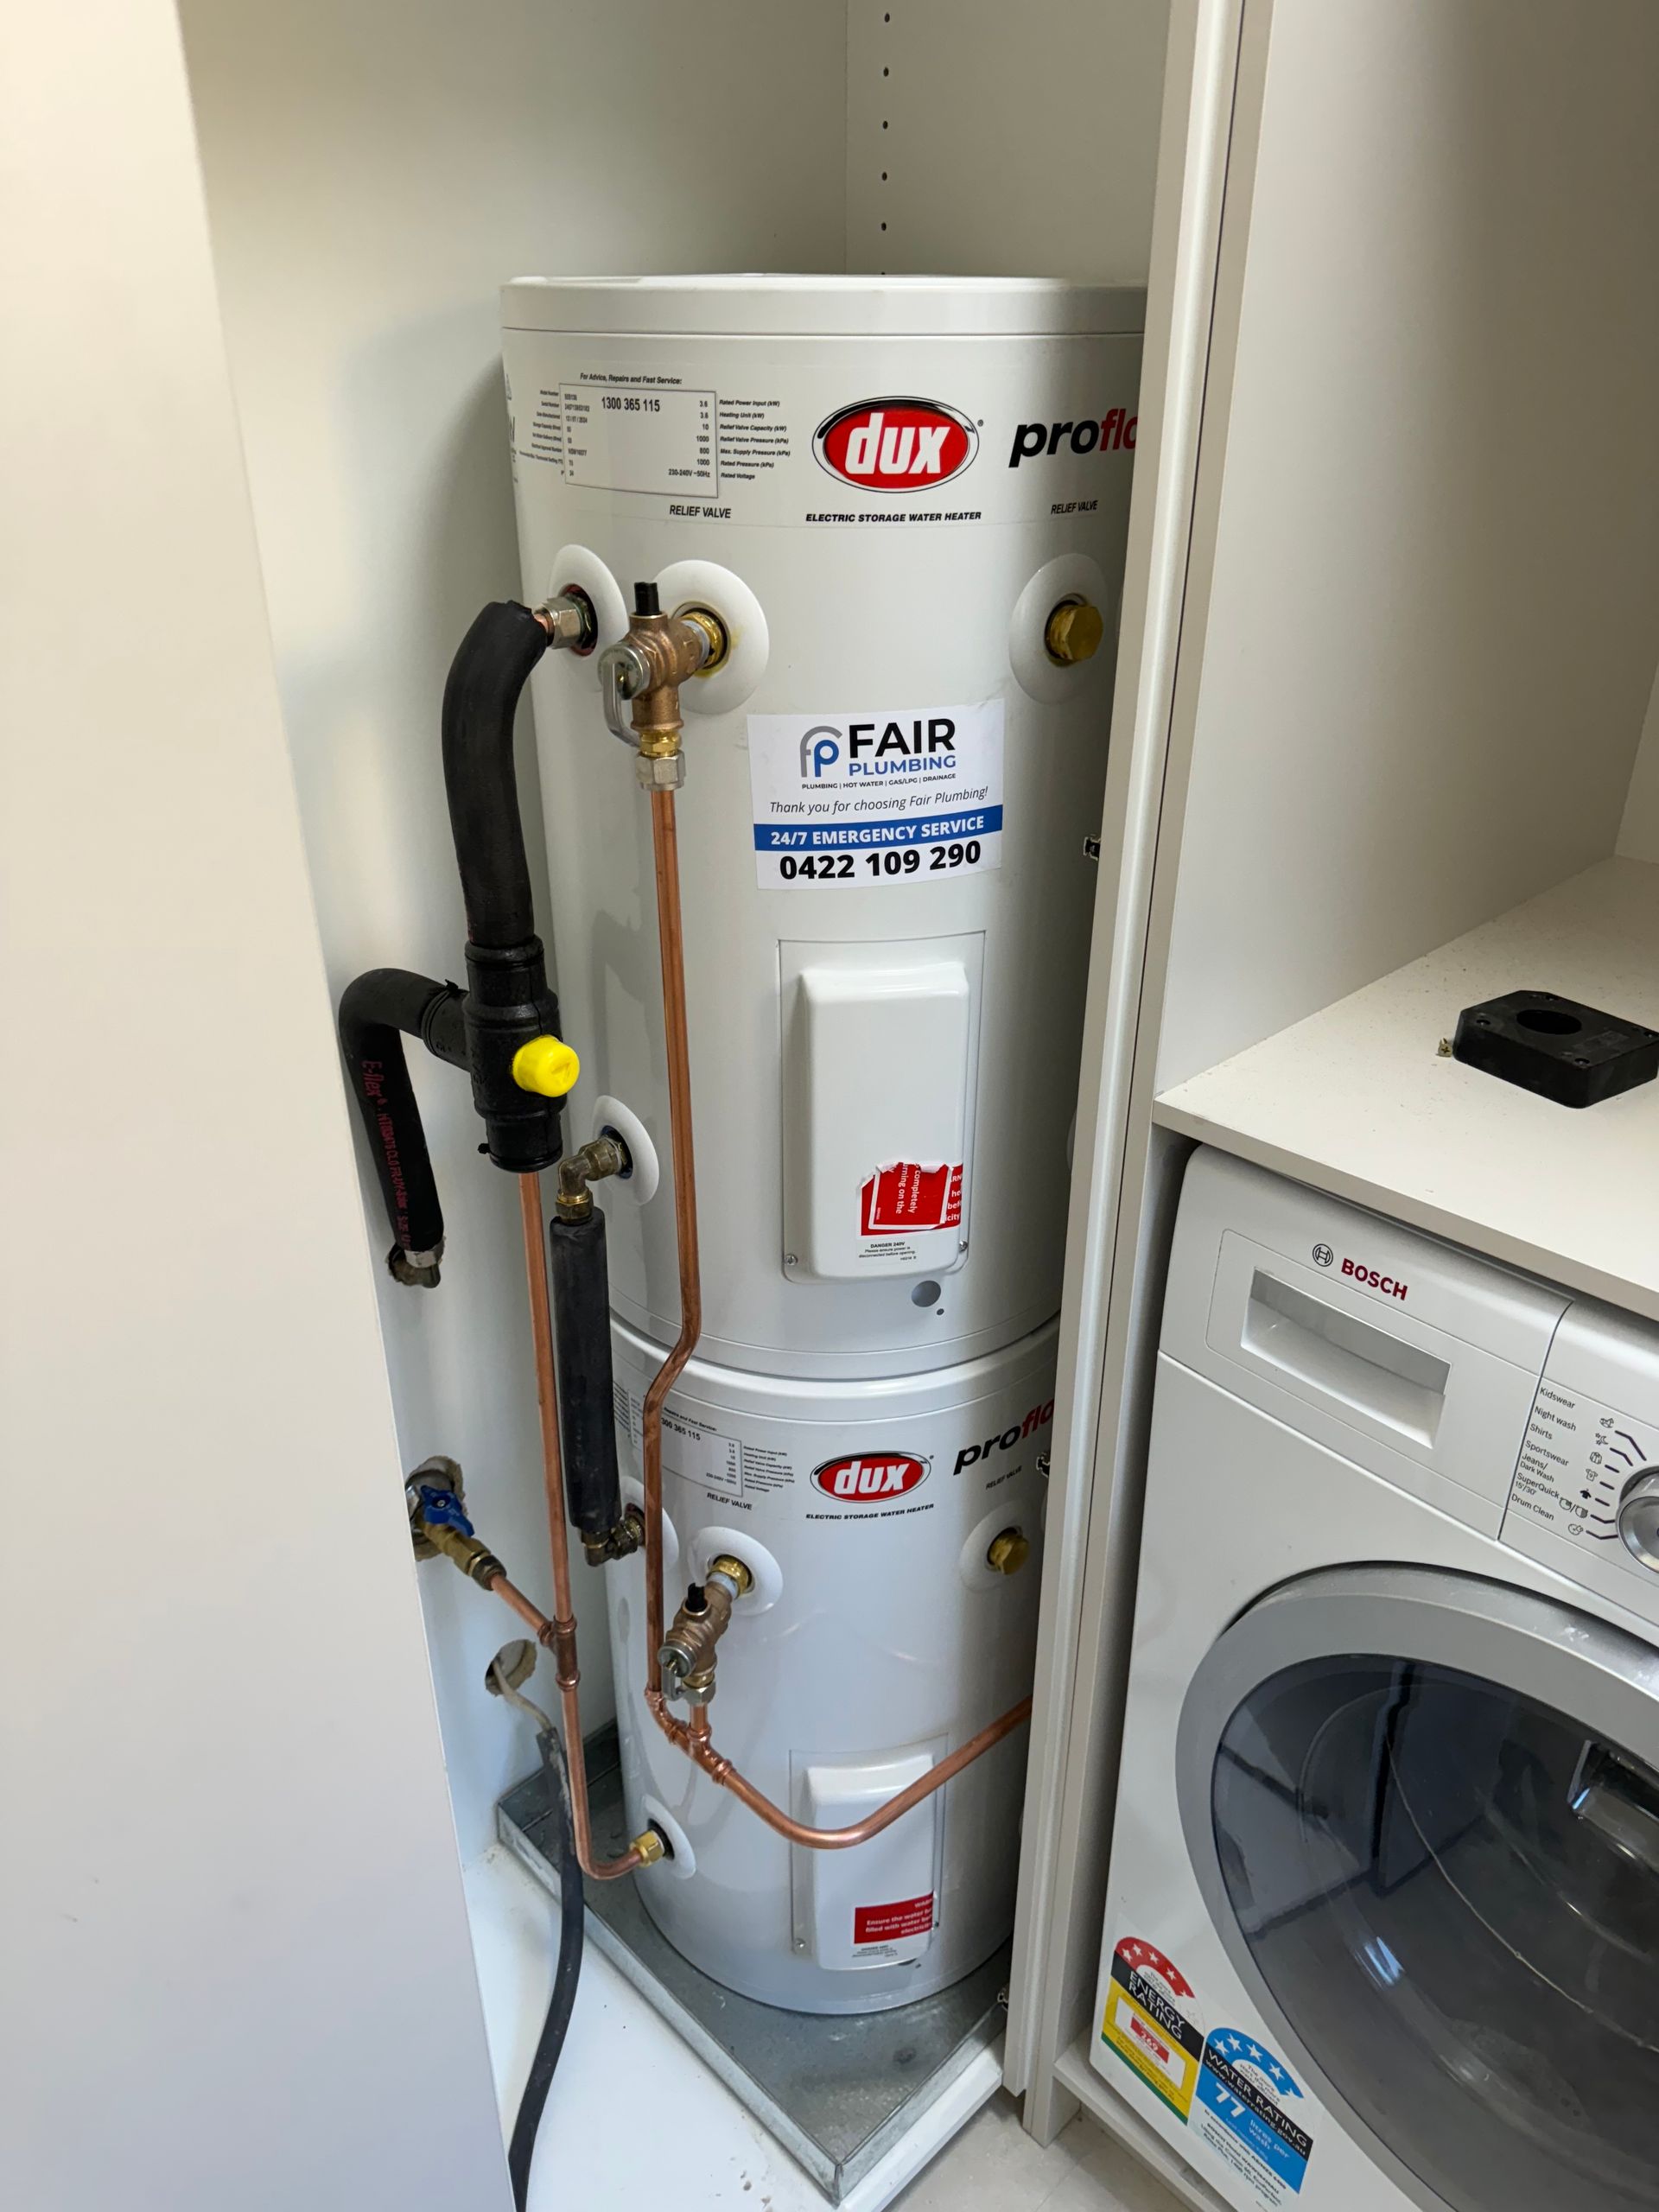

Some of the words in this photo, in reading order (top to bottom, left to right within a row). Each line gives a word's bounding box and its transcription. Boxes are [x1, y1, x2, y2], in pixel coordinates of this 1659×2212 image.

[589, 373, 607, 382] Advice,
[608, 374, 630, 383] Repairs
[601, 397, 621, 410] 1300
[624, 397, 640, 410] 365
[643, 398, 660, 412] 115
[844, 412, 950, 474] dux
[668, 468, 692, 477] 230-240V
[670, 505, 701, 517] RELIEF
[702, 506, 731, 518] VALVE
[805, 513, 855, 523] ELECTRIC
[858, 513, 906, 523] STORAGE
[908, 512, 942, 522] WATER
[944, 512, 982, 520] HEATER
[1051, 502, 1077, 515] RELIEF
[1077, 499, 1098, 512] VALVE
[849, 718, 956, 758] FAIR
[849, 755, 957, 776] PLUMBING
[923, 773, 957, 783] DRAINAGE
[770, 802, 805, 813] Thank
[808, 804, 830, 816] you
[831, 801, 851, 815] for
[854, 797, 906, 811] choosing
[910, 794, 931, 807] Fair
[935, 786, 988, 804] Plumbing!
[771, 831, 807, 845] 24/7
[812, 825, 918, 845] EMERGENCY
[921, 816, 984, 837] SERVICE
[779, 855, 855, 880] 0422
[865, 849, 920, 876] 109
[930, 840, 981, 870] 290
[899, 1189, 905, 1199] on
[907, 1170, 921, 1213] completely
[896, 1201, 905, 1214] the
[1341, 1257, 1408, 1300] BOSCH
[1540, 1387, 1575, 1409] Kidswear
[1535, 1406, 1555, 1422] Night
[1556, 1417, 1577, 1431] wash
[674, 1423, 686, 1434] 365
[688, 1430, 701, 1440] 115
[1529, 1423, 1553, 1440] Shirts
[1522, 1453, 1548, 1471] Jeans/
[1525, 1440, 1569, 1466] Sportswear
[833, 1460, 910, 1495] dux
[986, 1474, 1006, 1490] RELIEF
[1520, 1461, 1535, 1474] Dark
[1536, 1469, 1554, 1483] Wash
[1517, 1472, 1560, 1499] SuperQuick
[707, 1492, 730, 1505] RELIEF
[731, 1499, 753, 1510] VALVE
[906, 1503, 934, 1513] HEATER
[1511, 1493, 1532, 1510] Drum
[1533, 1504, 1554, 1521] Clean
[867, 1917, 890, 1926] Ensure
[904, 1910, 924, 1920] water
[900, 1918, 920, 1928] water
[1128, 1981, 1182, 2039] RATING
[1130, 1971, 1185, 2027] ENERGY
[1141, 2031, 1159, 2050] 269
[1206, 2059, 1306, 2157] www.waterrating.gov.au
[1209, 2049, 1252, 2097] WATER
[1255, 2095, 1307, 2147] RATING
[1216, 2082, 1246, 2118] 77
[1249, 2126, 1270, 2151] wash
[1249, 2120, 1272, 2143] litres
[1274, 2144, 1290, 2158] per
